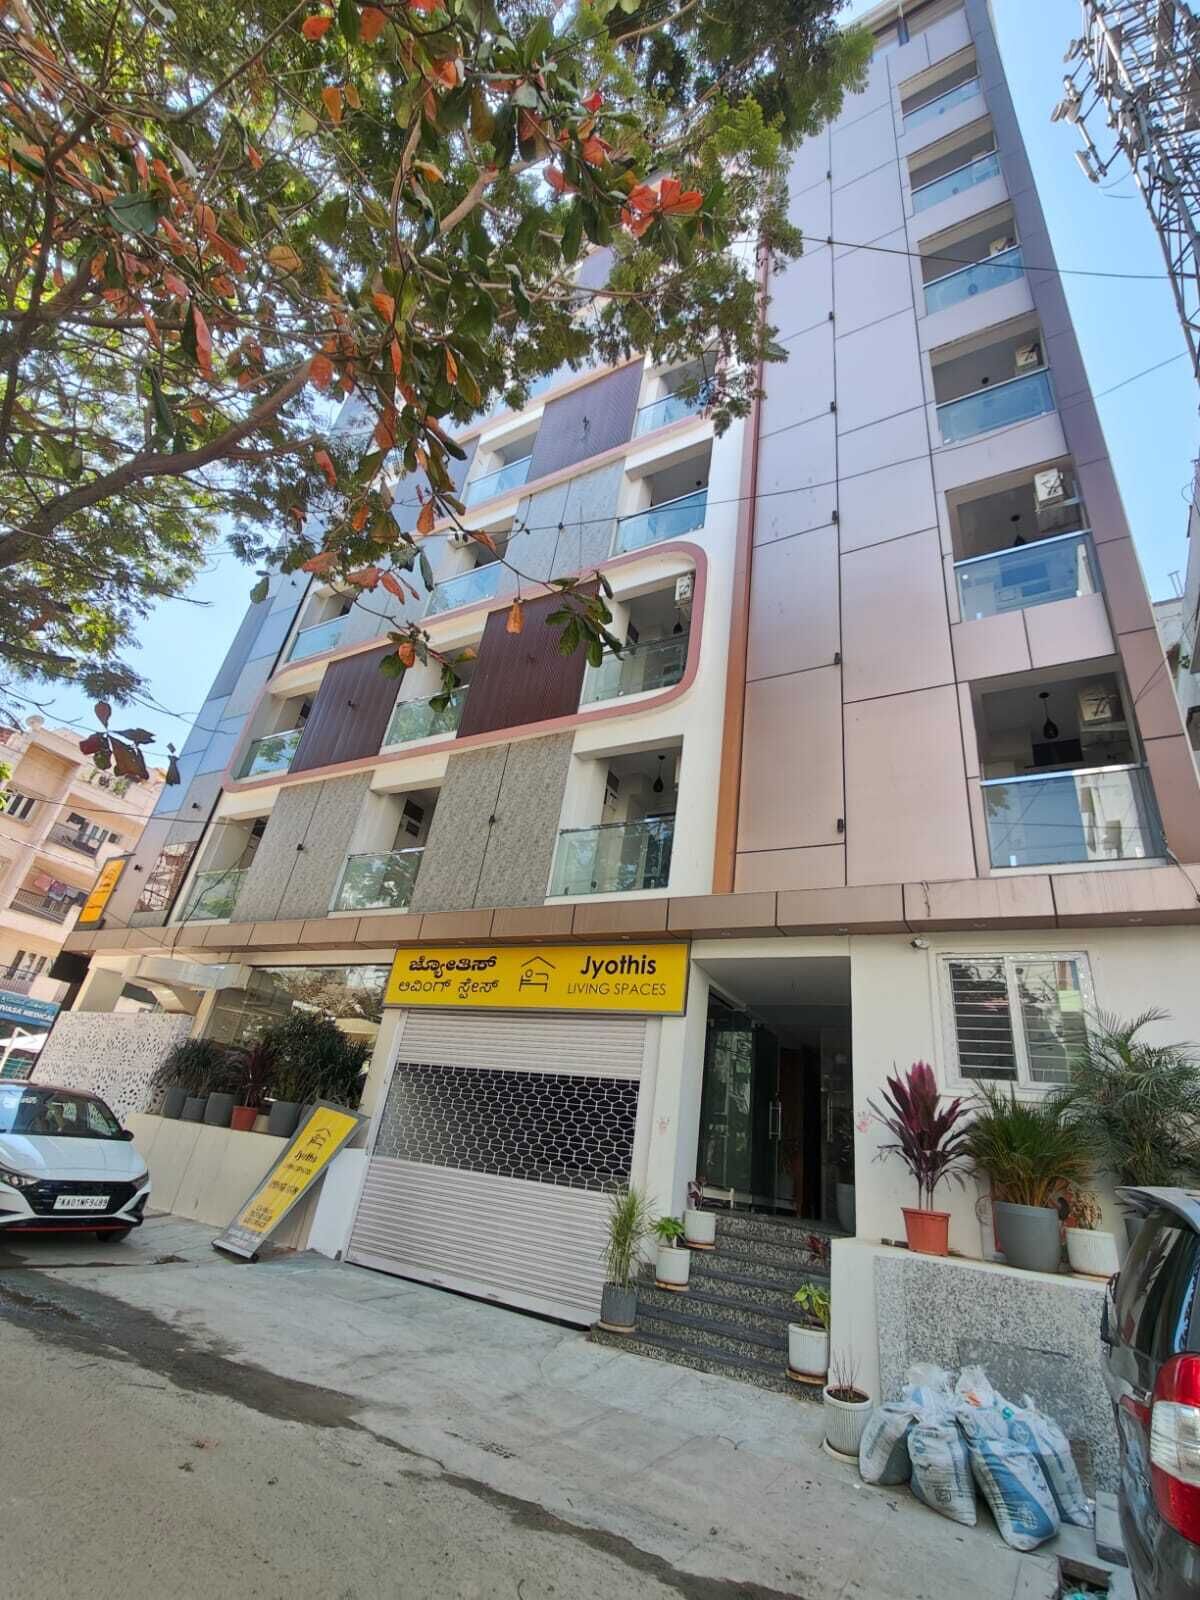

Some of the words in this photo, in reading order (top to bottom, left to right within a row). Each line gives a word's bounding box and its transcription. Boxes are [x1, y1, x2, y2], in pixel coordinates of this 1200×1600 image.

[580, 954, 657, 979] Jyothis
[567, 982, 610, 995] LIVING
[613, 982, 667, 996] SPACES
